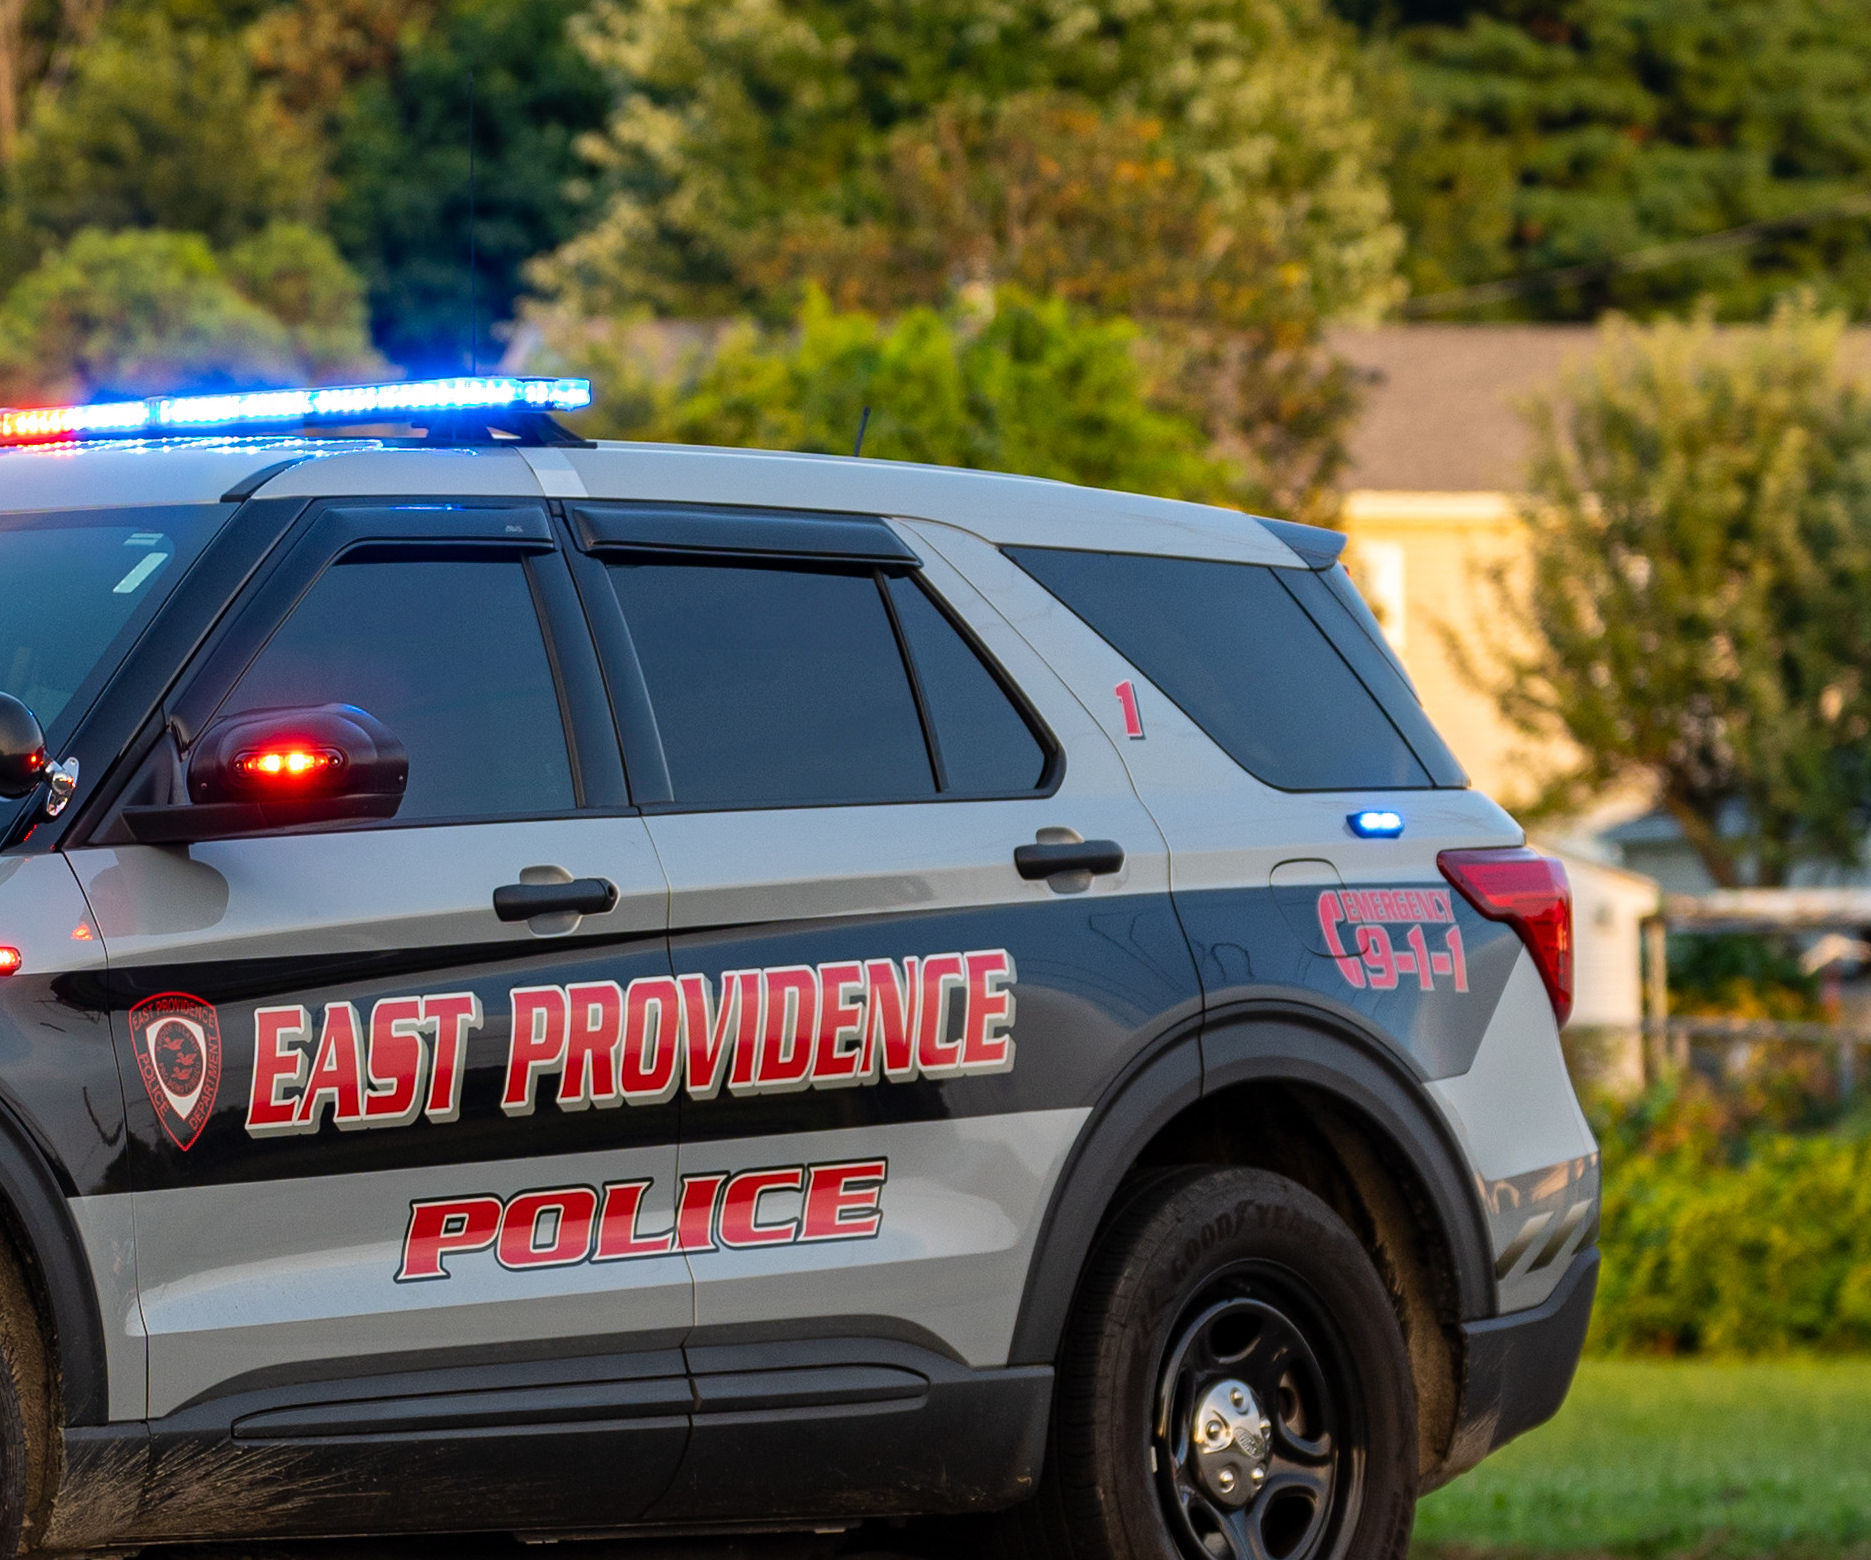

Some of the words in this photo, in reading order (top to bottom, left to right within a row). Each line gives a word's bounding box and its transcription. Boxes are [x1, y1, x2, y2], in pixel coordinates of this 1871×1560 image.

[1114, 679, 1146, 740] 1
[1336, 889, 1456, 923] EMERGENCY
[1356, 924, 1469, 992] 9-1-1
[132, 1004, 154, 1031] EAST
[156, 998, 216, 1029] PROVIDENCE
[245, 992, 484, 1138] EAST
[500, 948, 1017, 1117] PROVIDENCE
[137, 1053, 170, 1117] POLICE
[188, 1033, 218, 1130] DEPARTMENT
[393, 1156, 887, 1283] POLICE
